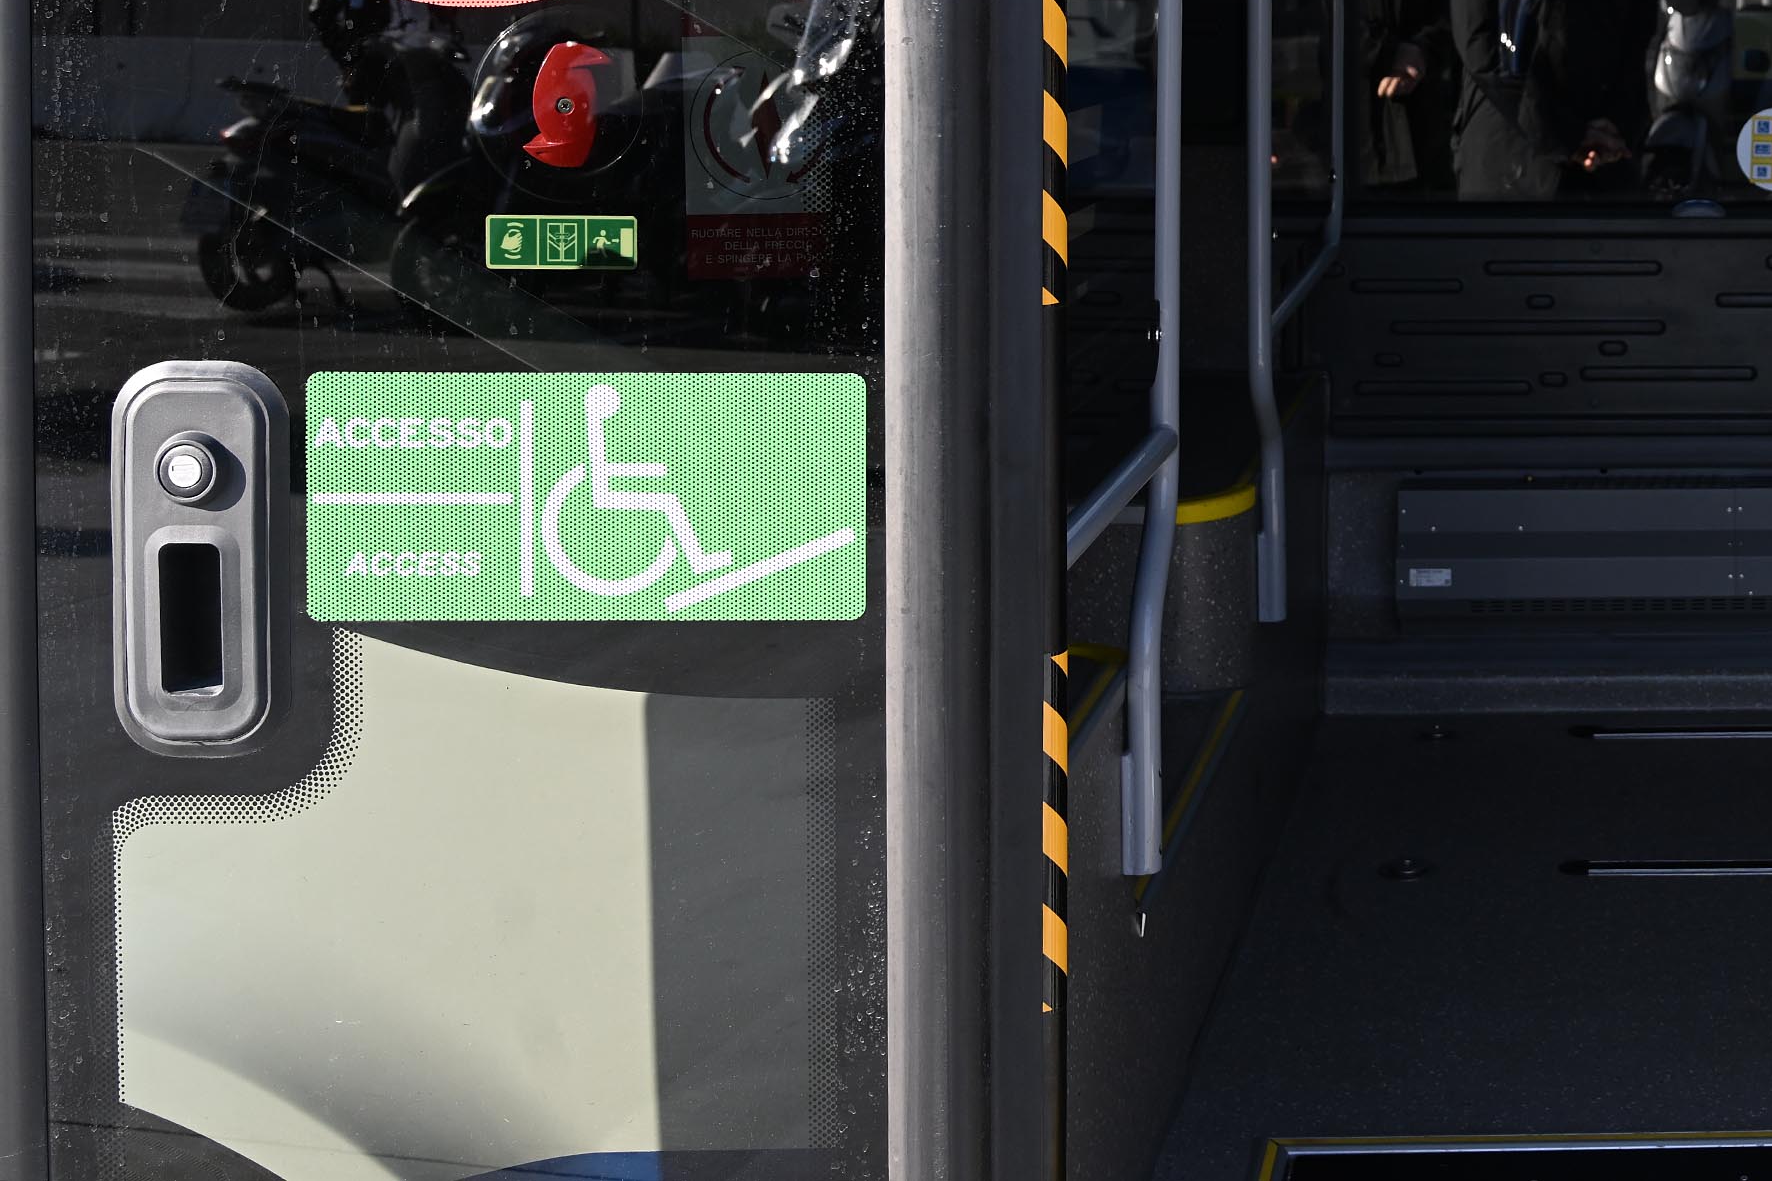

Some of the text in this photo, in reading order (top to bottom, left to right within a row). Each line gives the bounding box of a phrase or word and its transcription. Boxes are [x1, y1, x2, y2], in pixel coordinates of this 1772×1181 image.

[691, 227, 741, 238] RUOTARE
[747, 227, 782, 237] NELLA
[724, 240, 760, 251] DELLA
[705, 254, 713, 264] E
[718, 253, 773, 264] SPINGERE
[777, 252, 792, 263] LA
[313, 416, 514, 449] ACCESSO
[344, 550, 484, 578] ACCESS
